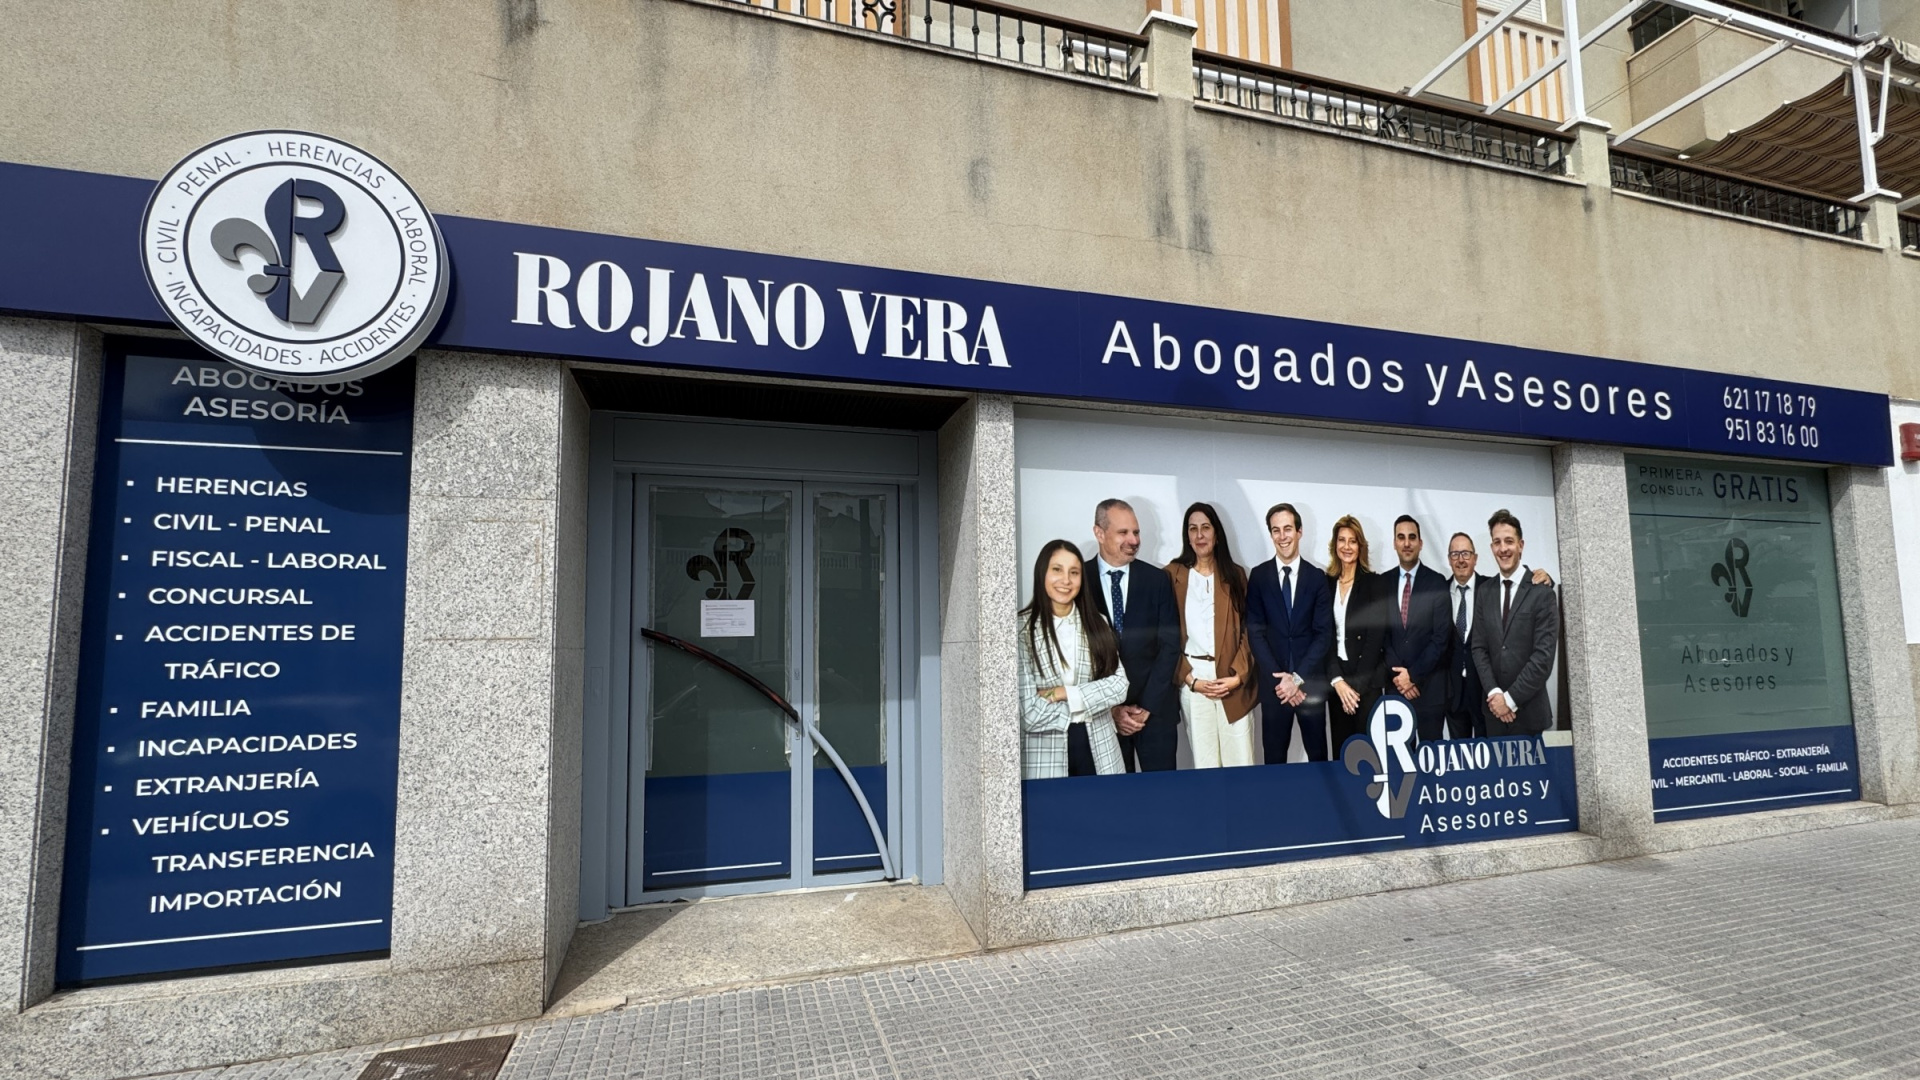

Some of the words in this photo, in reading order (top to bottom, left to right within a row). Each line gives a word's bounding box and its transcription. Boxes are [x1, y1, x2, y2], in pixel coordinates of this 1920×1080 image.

[178, 151, 240, 196] PENAL
[268, 141, 385, 189] HERENCIAS
[157, 218, 180, 263] CIVIL
[396, 206, 427, 285] LABORAL
[167, 281, 302, 365] INCAPACIDADES
[319, 301, 416, 364] ACCIDENTES
[511, 251, 825, 350] ROJANO
[837, 288, 1012, 368] VERA
[1101, 320, 1403, 393] Abogados
[183, 396, 350, 424] ASESORÍA
[1724, 386, 1749, 410] 621
[1754, 390, 1770, 413] 17
[1776, 392, 1792, 416] 18
[1798, 396, 1816, 418] 79
[1725, 418, 1751, 441] 951
[1756, 421, 1775, 444] 83
[1780, 424, 1796, 446] 16
[1800, 426, 1818, 448] 00
[1640, 466, 1703, 481] PRIMERA
[157, 477, 307, 497] HERENCIAS
[1640, 484, 1703, 497] CONSULTA
[1713, 472, 1799, 503] GRATIS
[154, 513, 221, 531] CIVIL
[245, 516, 330, 533] PENAL
[151, 551, 243, 568] FISCAL
[267, 552, 386, 570] LABORAL
[148, 588, 313, 605] CONCURSAL
[145, 624, 313, 642] ACCIDENTES
[321, 624, 355, 640] DE
[1681, 643, 1779, 668] Abogados
[1785, 647, 1793, 665] y
[165, 658, 280, 680] TRÁFICO
[1684, 674, 1776, 693] Asesores
[141, 699, 251, 718] FAMILIA
[138, 733, 357, 757] INCAPACIDADES
[1491, 739, 1547, 768] VERA
[1663, 755, 1718, 768] ACCIDENTES
[1720, 754, 1732, 764] DE
[1735, 750, 1769, 763] TRÁFICO
[1777, 744, 1830, 759] EXTRANJERÍA
[135, 768, 319, 796] EXTRANJERÍA
[1651, 778, 1668, 789] IVIL
[1676, 772, 1727, 786] MERCANTIL
[1733, 769, 1773, 781] LABORAL
[1779, 765, 1808, 776] SOCIAL
[1816, 762, 1848, 773] FAMILIA
[1418, 779, 1532, 805] Abogados
[1539, 780, 1549, 799] y
[132, 809, 290, 835] VEHÍCULOS
[1420, 808, 1528, 834] Asesores
[152, 842, 374, 873] TRANSFERENCIA
[150, 879, 341, 913] IMPORTACIÓN
